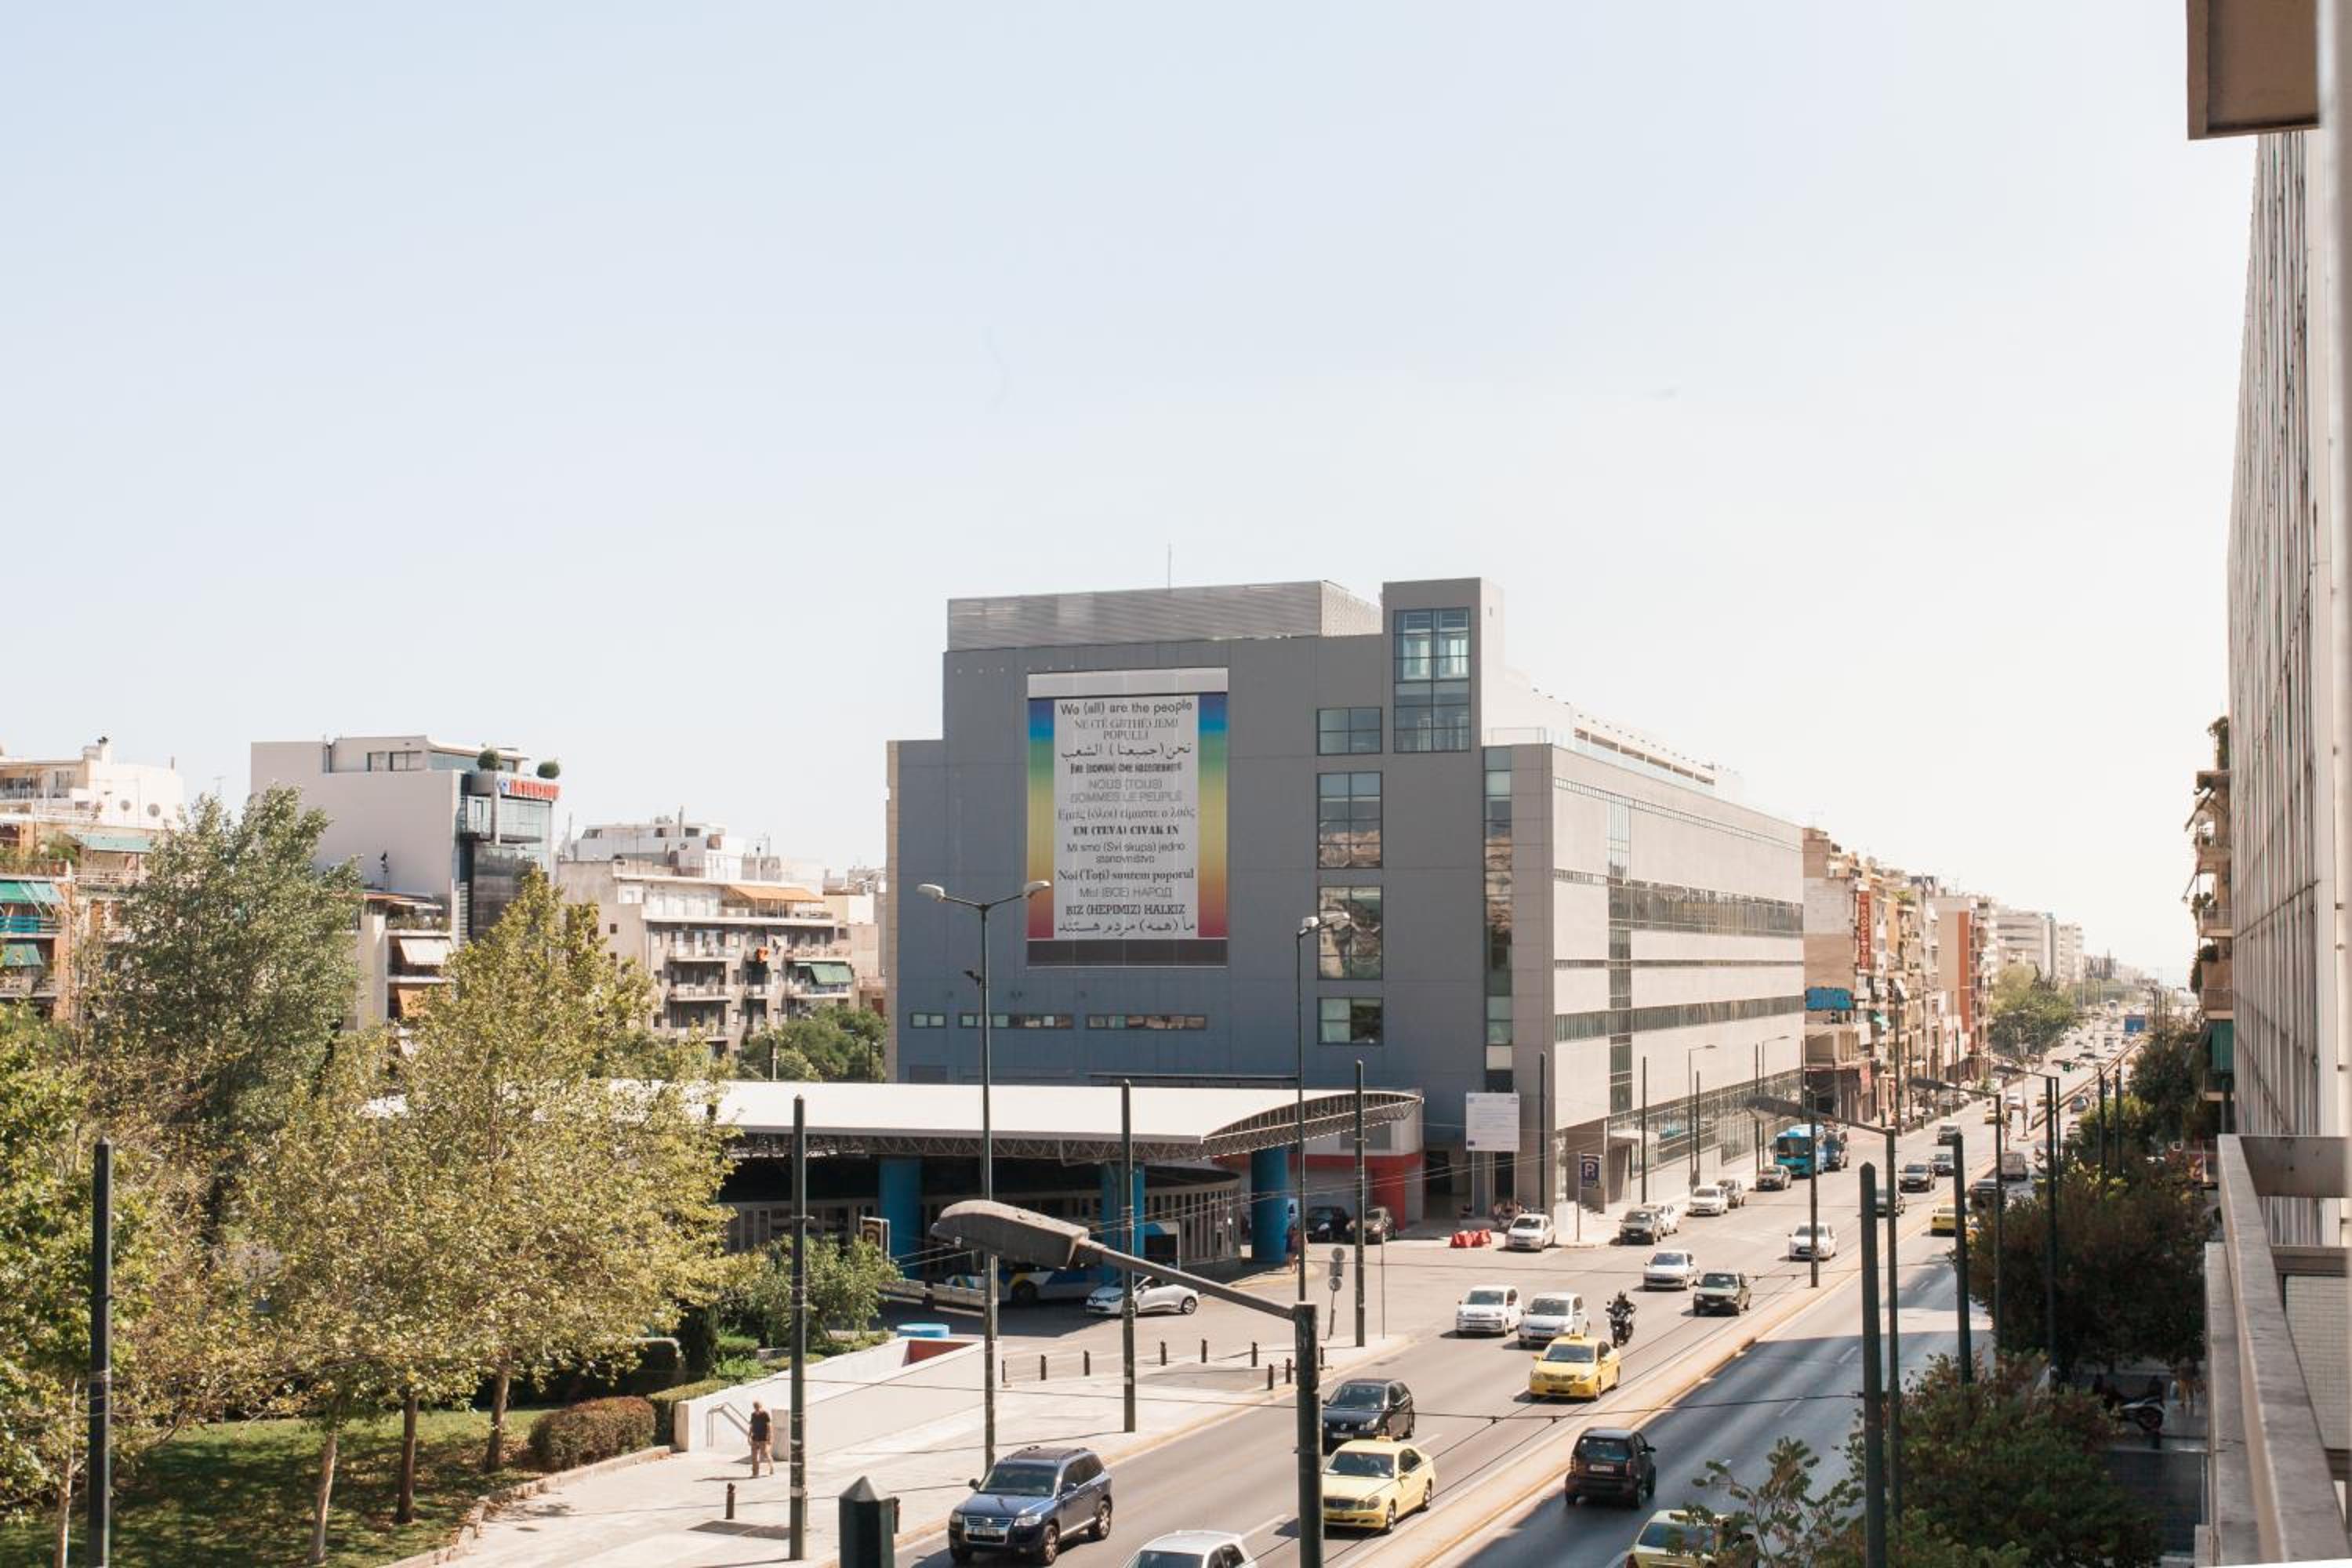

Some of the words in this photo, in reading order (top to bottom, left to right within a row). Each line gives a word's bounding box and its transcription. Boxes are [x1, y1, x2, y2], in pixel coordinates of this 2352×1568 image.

[1060, 703, 1080, 715] We
[1083, 702, 1105, 715] (all)
[1110, 703, 1128, 713] are
[1132, 702, 1150, 713] the
[1154, 699, 1192, 715] people
[1103, 730, 1149, 741] POPULLI
[1089, 779, 1122, 790] NOUS
[1125, 778, 1163, 790] (TOUS)
[1070, 792, 1121, 803] SOMMES
[1139, 790, 1182, 802] PEUPLE
[1080, 844, 1101, 852] smo
[1103, 841, 1122, 852] (Svi
[1123, 841, 1156, 853] skupa)
[1159, 840, 1186, 853] jedno
[1058, 869, 1077, 880] Noi
[1152, 867, 1194, 884] poporul
